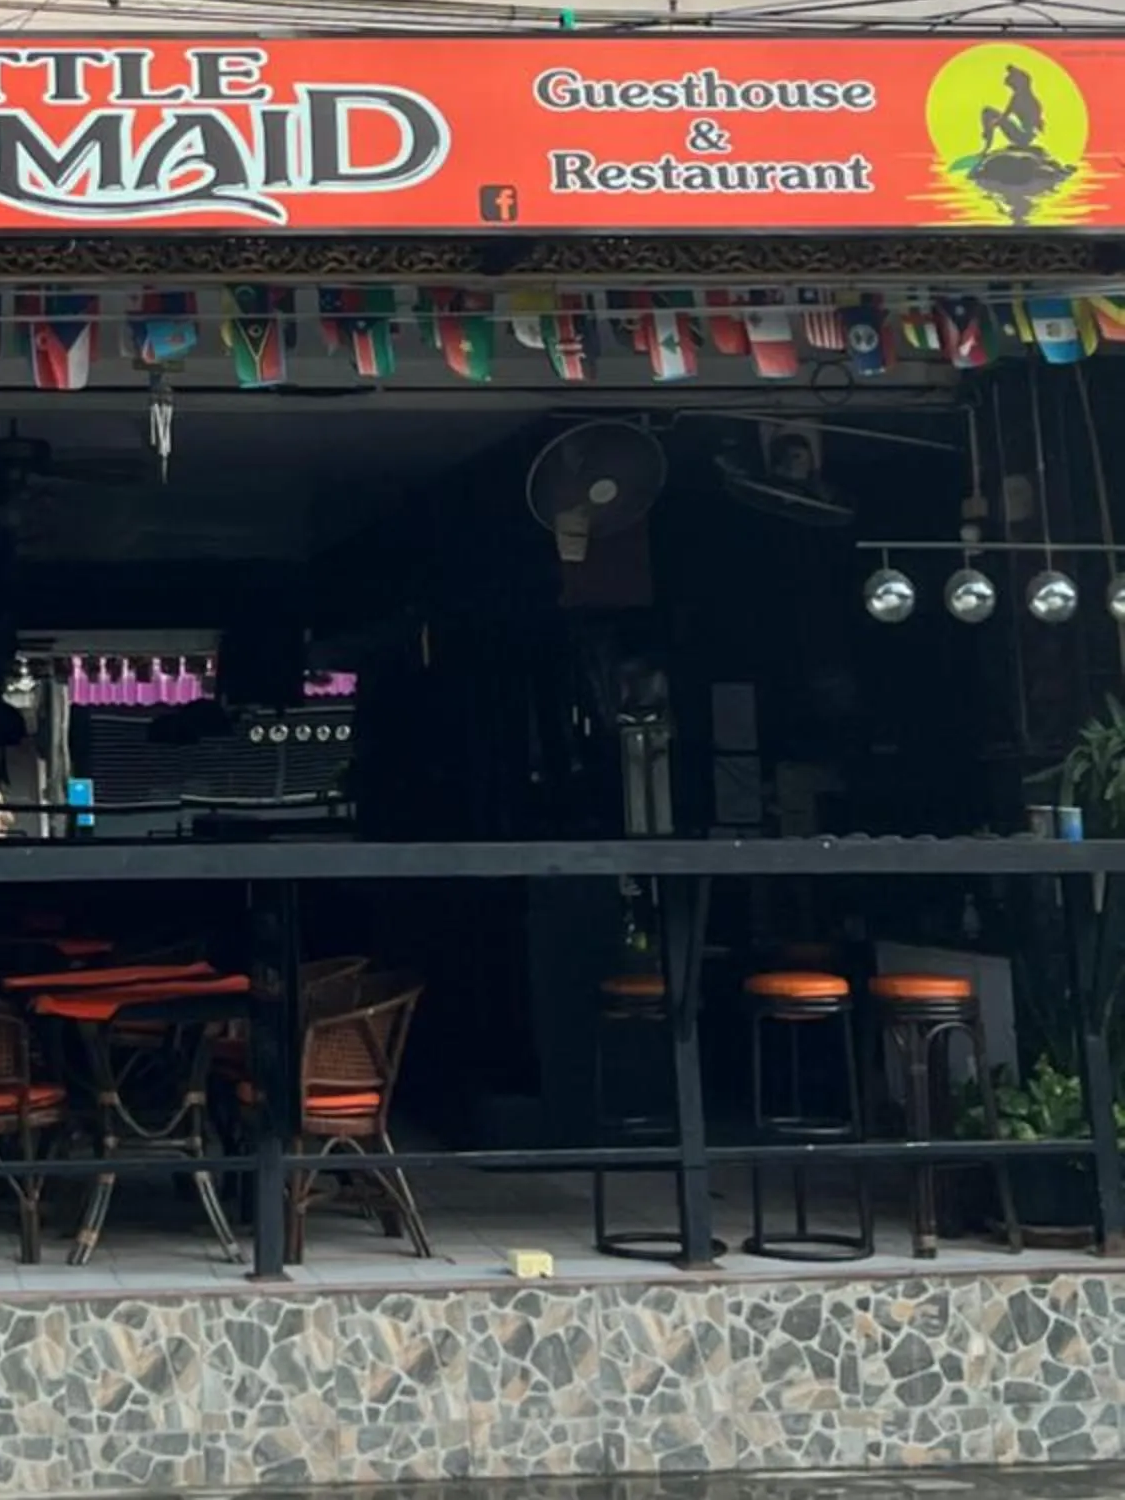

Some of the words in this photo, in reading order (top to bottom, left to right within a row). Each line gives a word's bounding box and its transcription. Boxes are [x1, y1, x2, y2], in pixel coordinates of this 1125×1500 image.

[535, 68, 875, 111] Guesthouse
[687, 118, 732, 152] &
[550, 152, 874, 194] Restaurant
